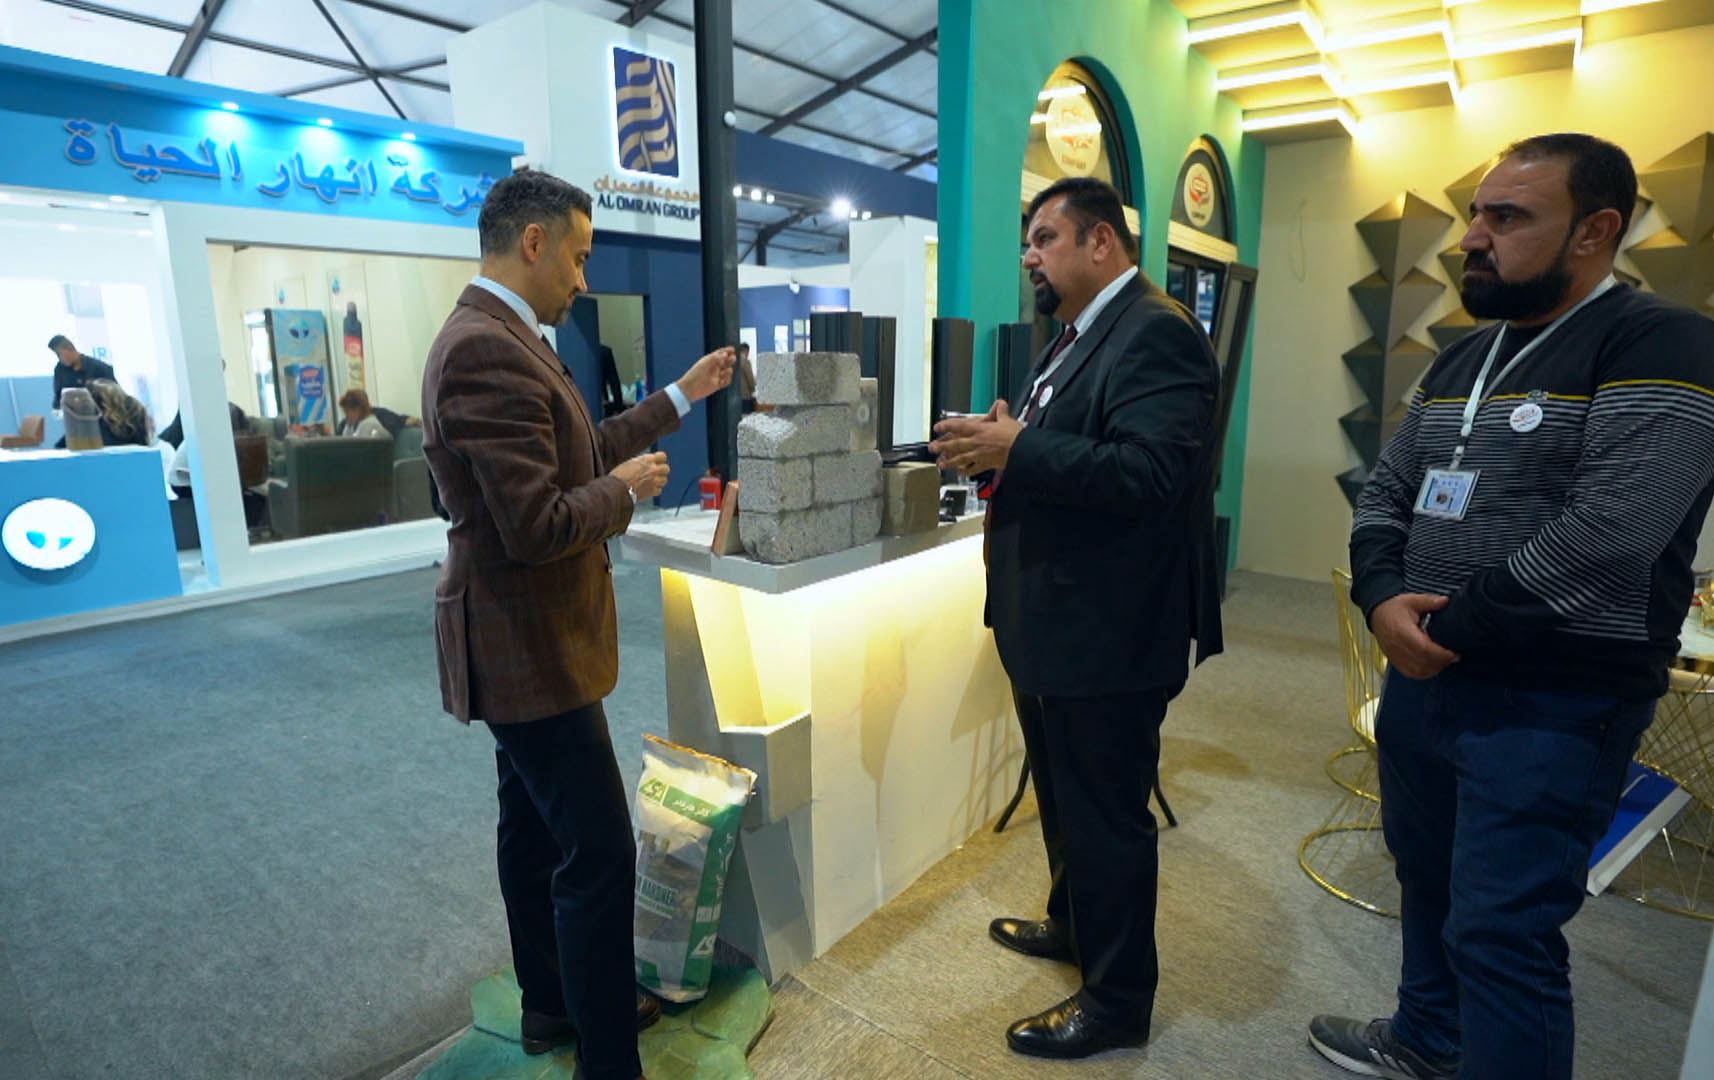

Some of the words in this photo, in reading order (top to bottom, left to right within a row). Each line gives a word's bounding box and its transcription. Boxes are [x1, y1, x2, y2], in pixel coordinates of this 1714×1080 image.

[64, 119, 242, 184] الحياة
[257, 151, 378, 203] انهار
[597, 193, 615, 210] AL
[616, 196, 661, 216] OMRAN
[663, 202, 700, 221] GROUP
